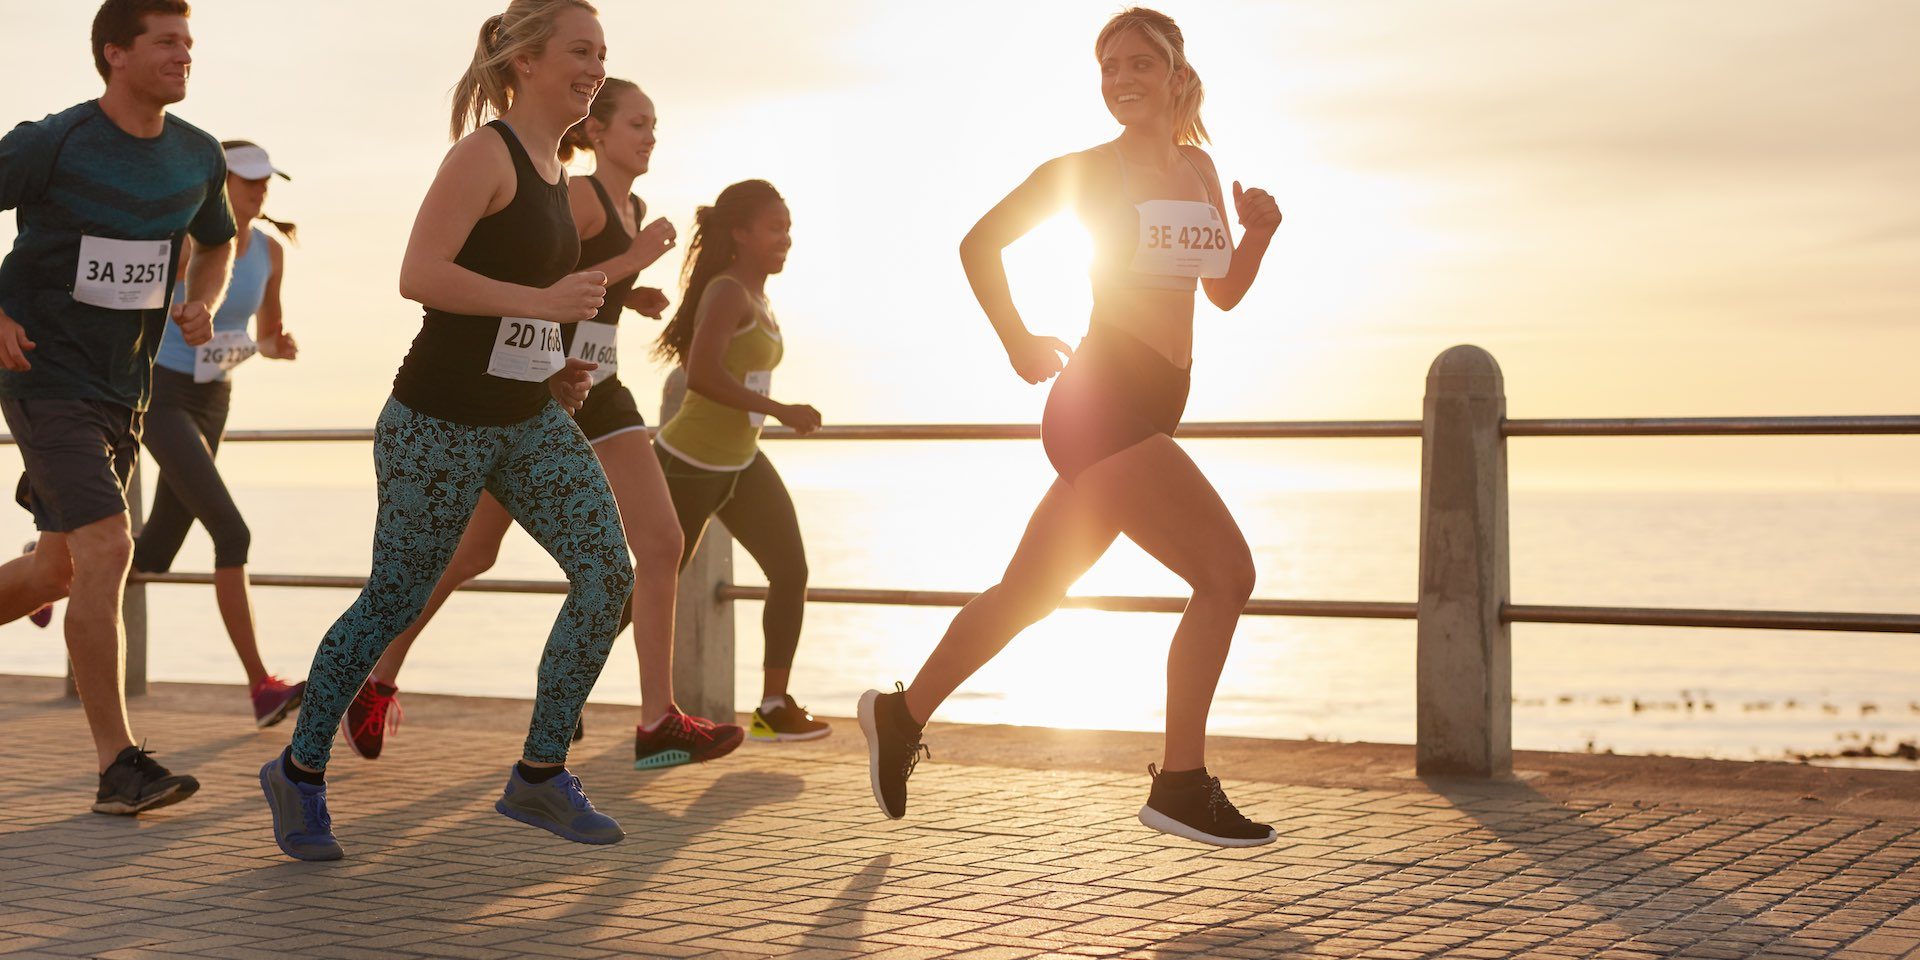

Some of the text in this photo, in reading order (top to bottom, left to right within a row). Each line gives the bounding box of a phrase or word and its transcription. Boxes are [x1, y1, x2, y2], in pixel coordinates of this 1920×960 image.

[1147, 225, 1226, 250] 3E 4226
[86, 260, 164, 284] 3A 3251
[504, 322, 536, 349] 2D
[202, 347, 224, 364] 2G
[580, 341, 596, 361] M
